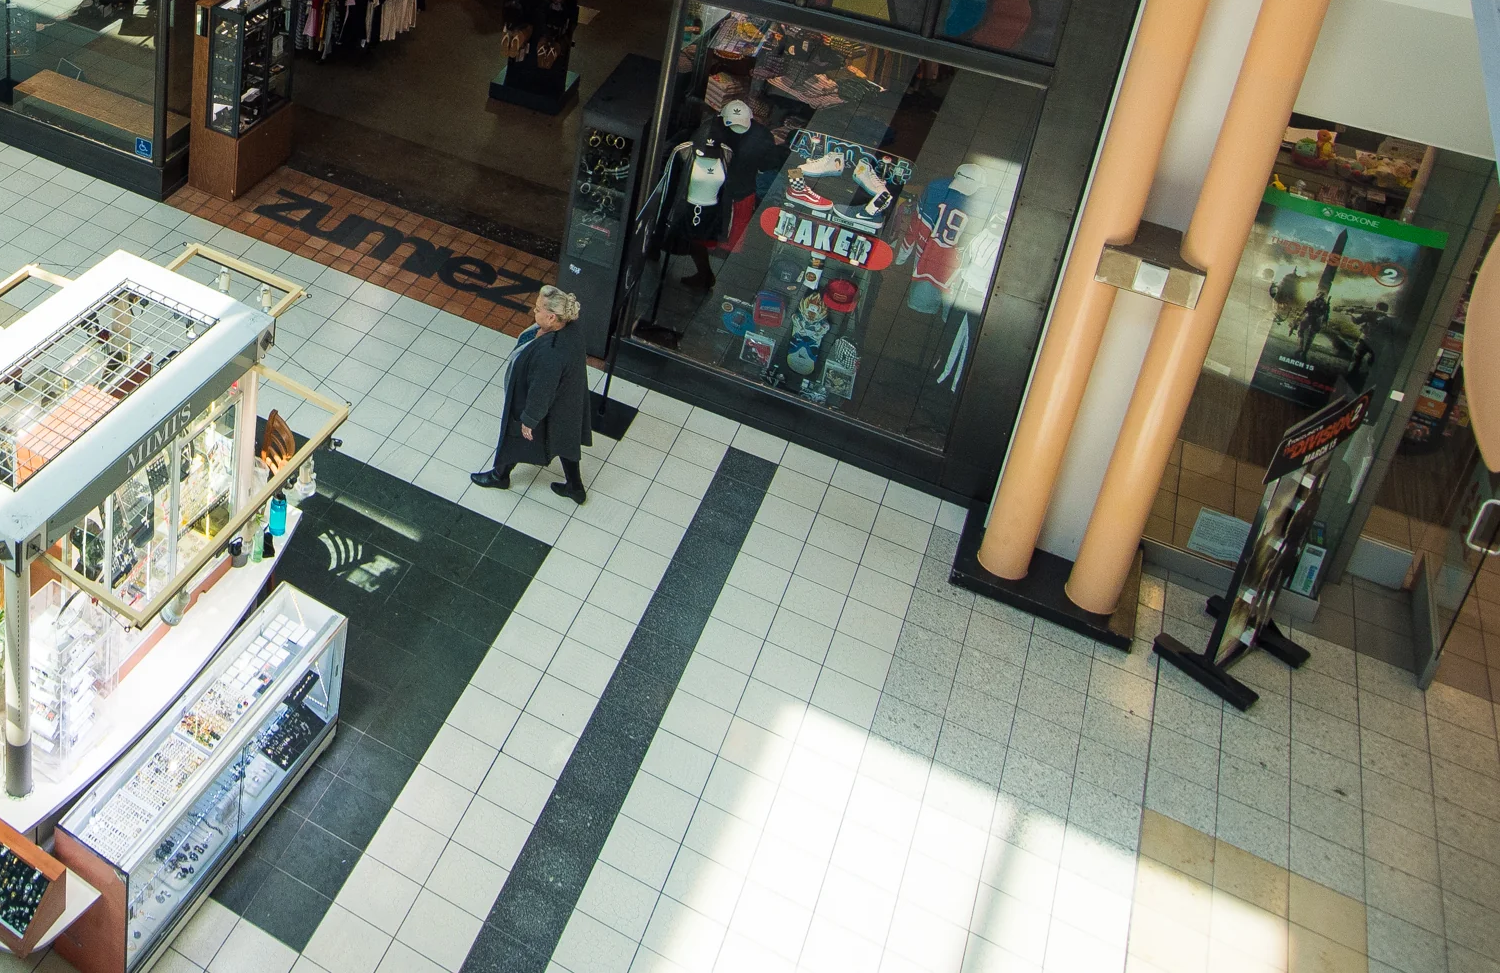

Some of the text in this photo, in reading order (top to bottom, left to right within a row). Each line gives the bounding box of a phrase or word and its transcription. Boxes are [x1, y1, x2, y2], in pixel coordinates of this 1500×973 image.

[773, 210, 872, 265] BAKER
[931, 203, 969, 248] 19
[1335, 210, 1381, 228] XBOX ONE
[1285, 240, 1398, 283] DIVISION 2
[1278, 355, 1315, 371] MARCH 15
[125, 403, 191, 474] MIMI'S
[1289, 410, 1354, 459] DIVISION
[1351, 403, 1363, 423] 2
[1302, 437, 1338, 465] MARCH 15
